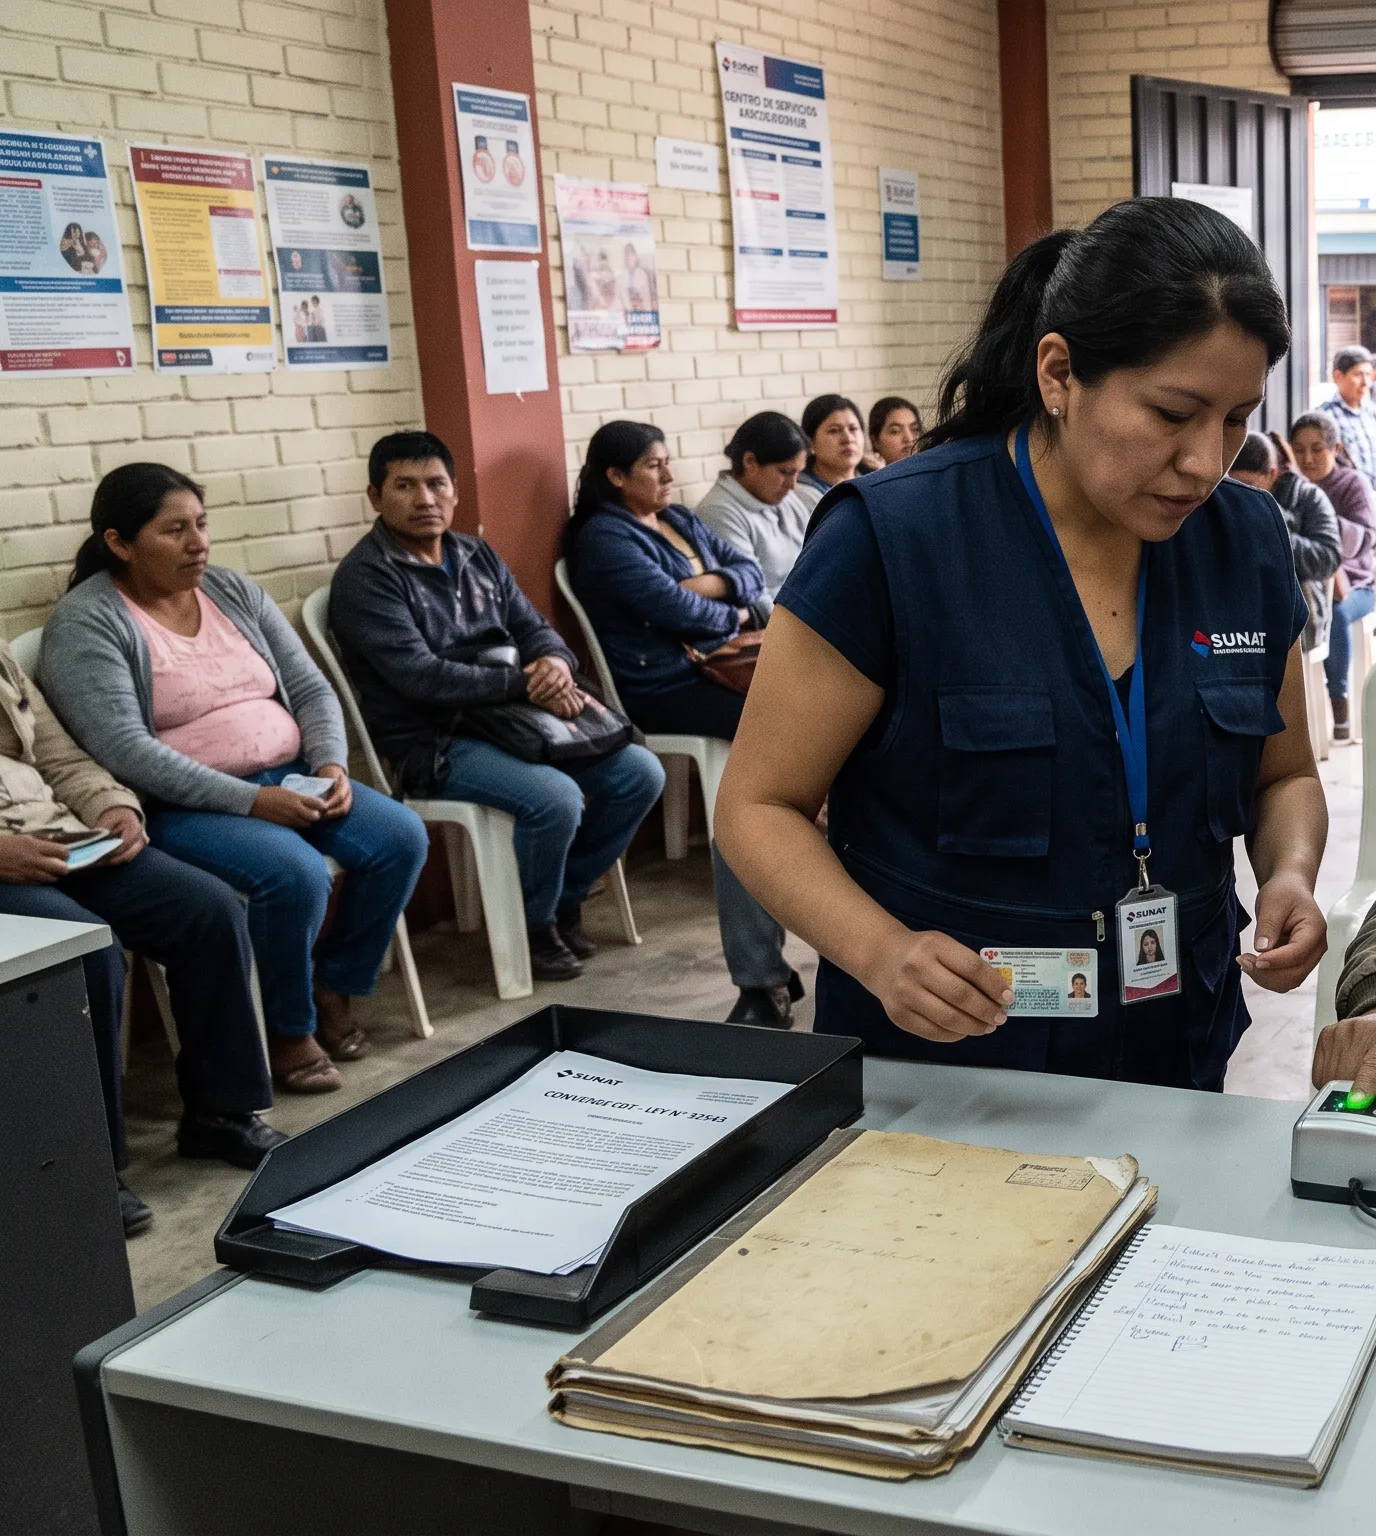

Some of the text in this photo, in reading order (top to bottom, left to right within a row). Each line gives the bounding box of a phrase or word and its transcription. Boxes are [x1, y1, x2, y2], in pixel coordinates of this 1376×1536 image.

[724, 90, 761, 106] CENTRO
[1210, 632, 1266, 648] SUNAT
[1135, 906, 1167, 918] SUNAT
[572, 1072, 623, 1086] SUNAT
